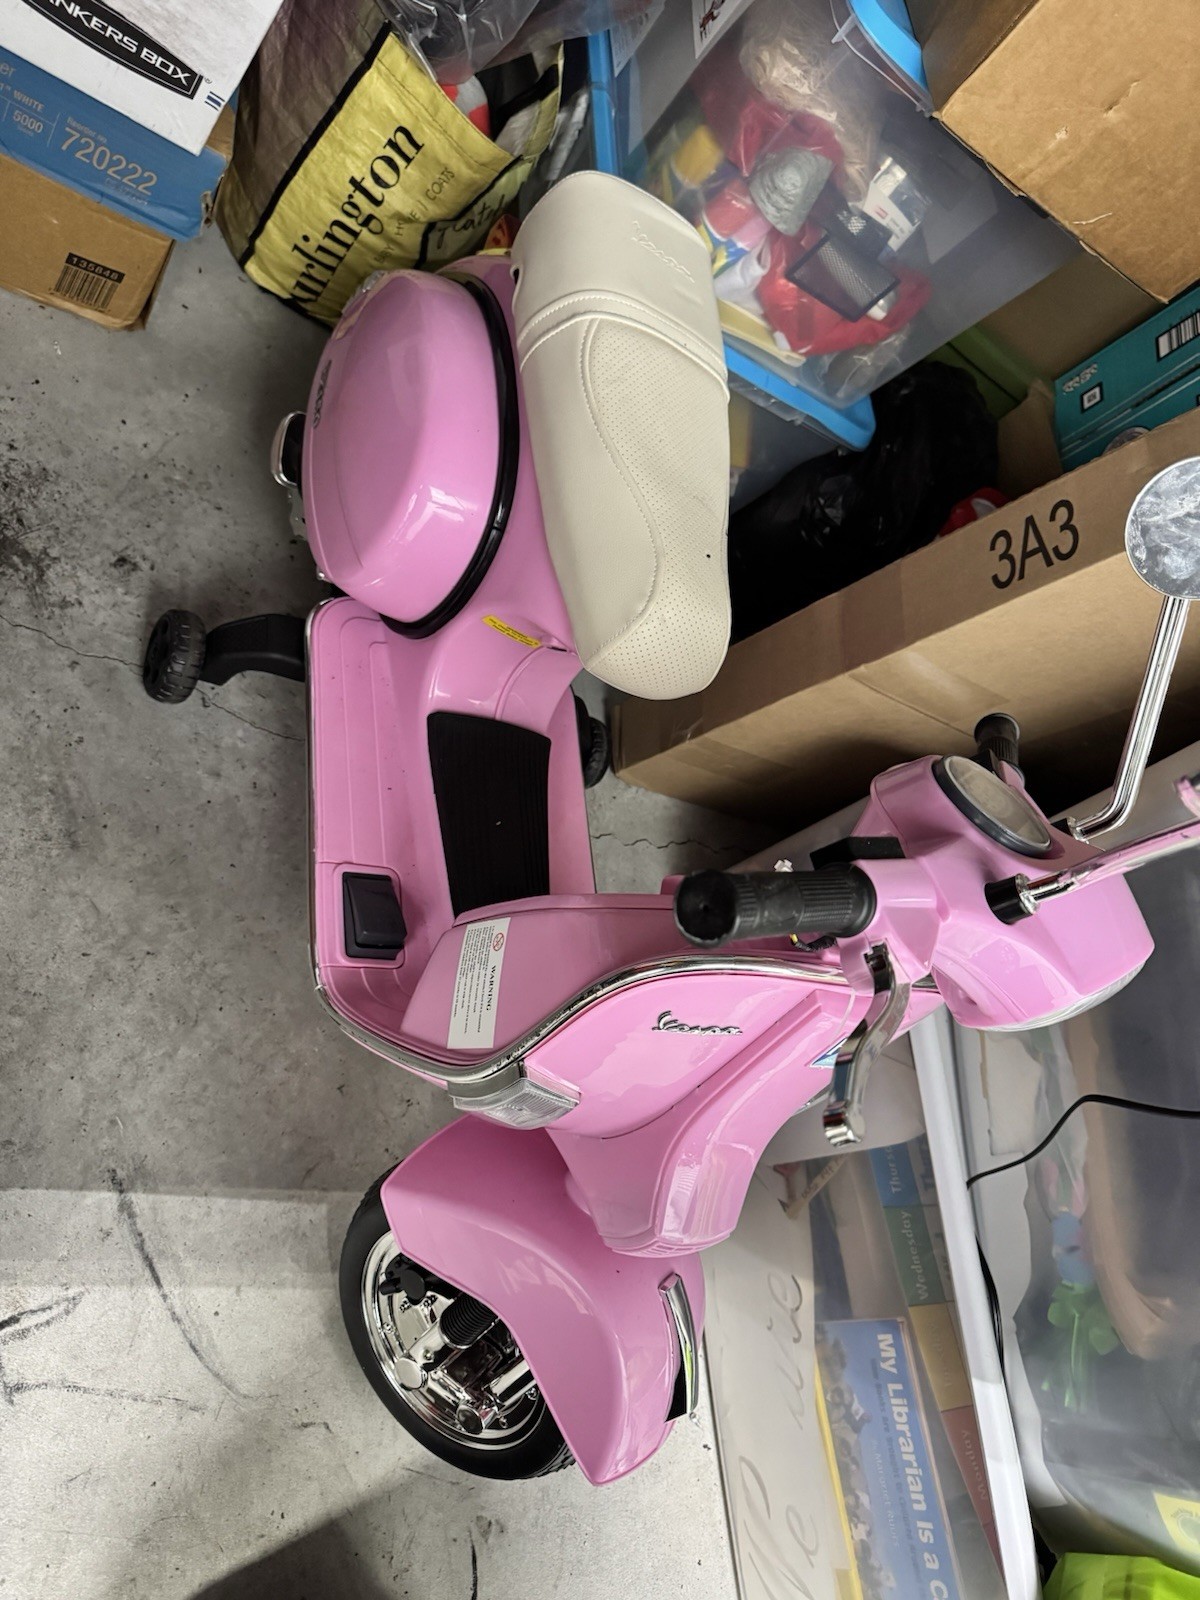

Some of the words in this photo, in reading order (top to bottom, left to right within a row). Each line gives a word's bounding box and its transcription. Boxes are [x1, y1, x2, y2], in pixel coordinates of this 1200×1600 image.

[140, 47, 192, 86] BOX
[13, 90, 45, 112] WHITE
[13, 110, 43, 133] 5000
[61, 126, 157, 196] 720222
[424, 167, 456, 201] COATS
[989, 499, 1079, 589] 3A3
[486, 965, 497, 1011] WARNING
[651, 1010, 743, 1036] Vespa
[901, 1211, 929, 1300] Wednesday
[877, 1334, 898, 1374] My
[887, 1383, 927, 1511] Librarian
[961, 1429, 988, 1500] Monday
[916, 1521, 934, 1544] Is
[923, 1552, 940, 1570] a
